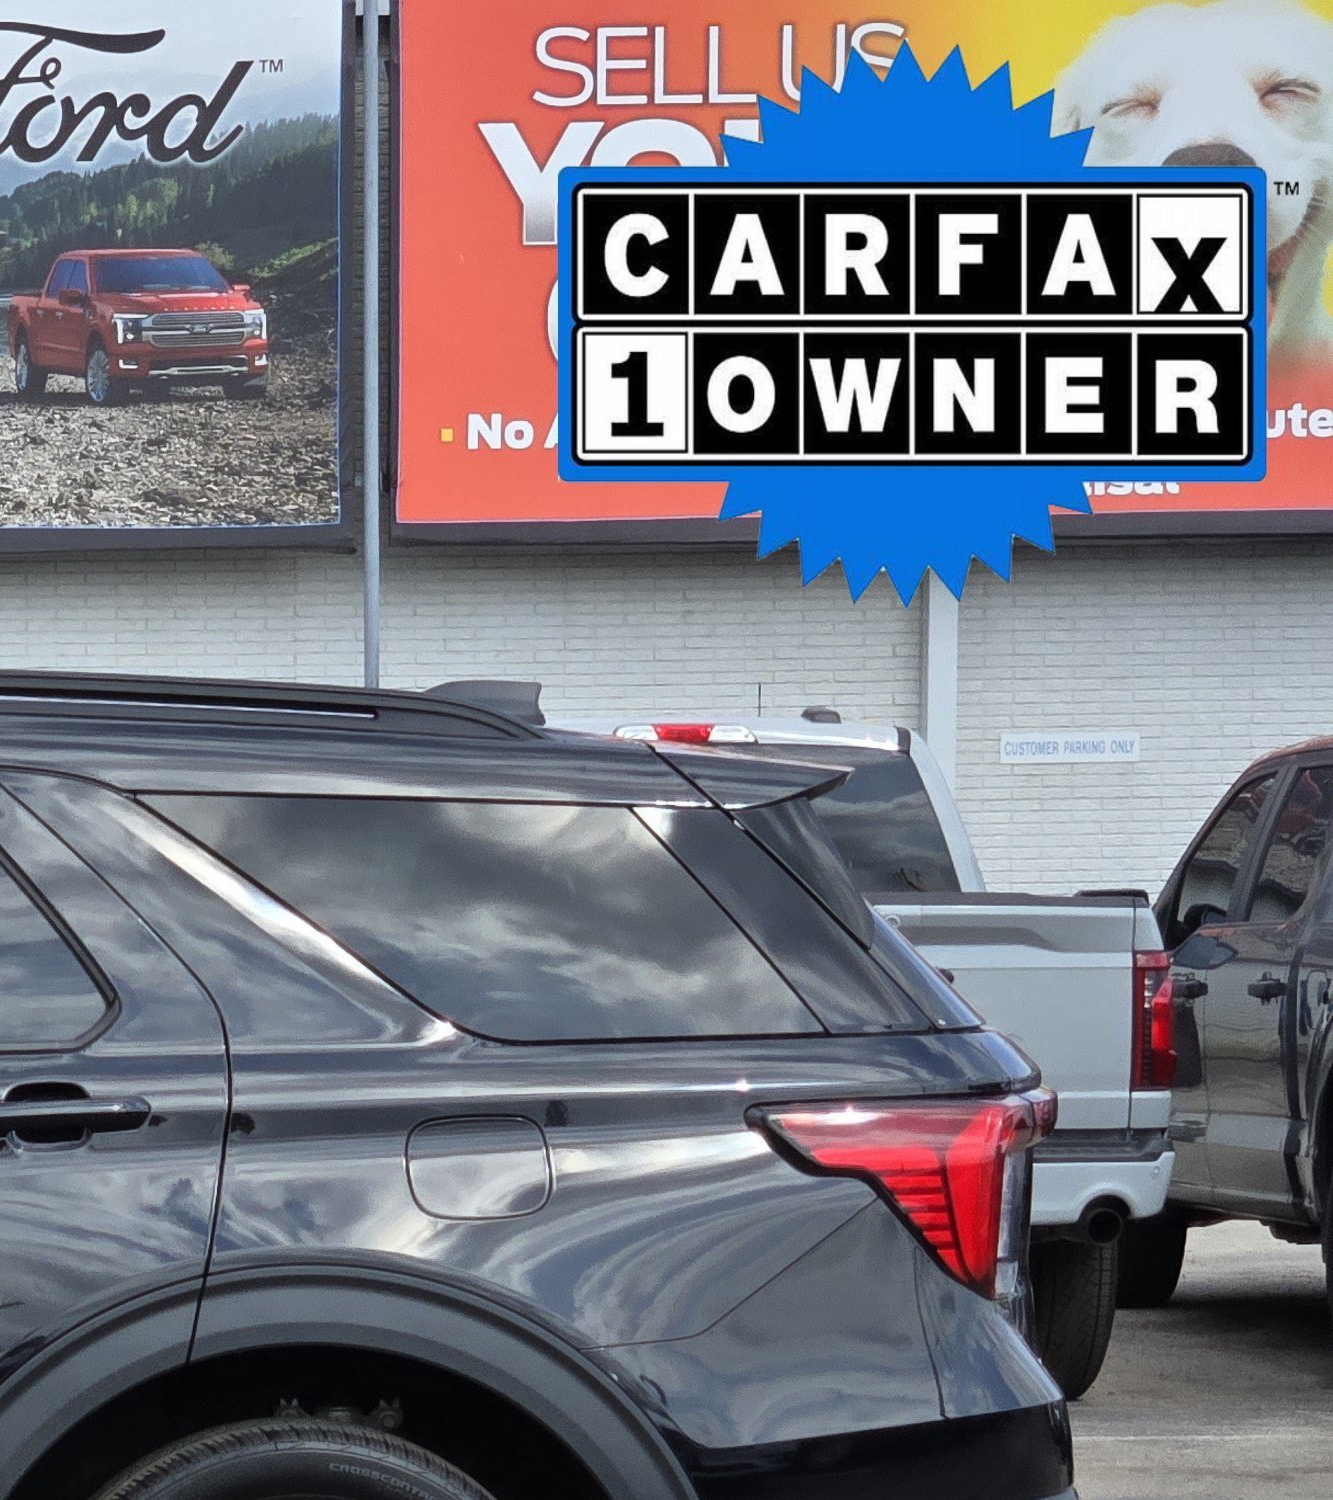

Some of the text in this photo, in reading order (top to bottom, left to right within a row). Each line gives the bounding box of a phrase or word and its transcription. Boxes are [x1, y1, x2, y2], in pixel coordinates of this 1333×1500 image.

[532, 24, 758, 107] SELL
[466, 413, 535, 450] No
[1004, 739, 1135, 756] CUSTOMER PARKING ONLY
